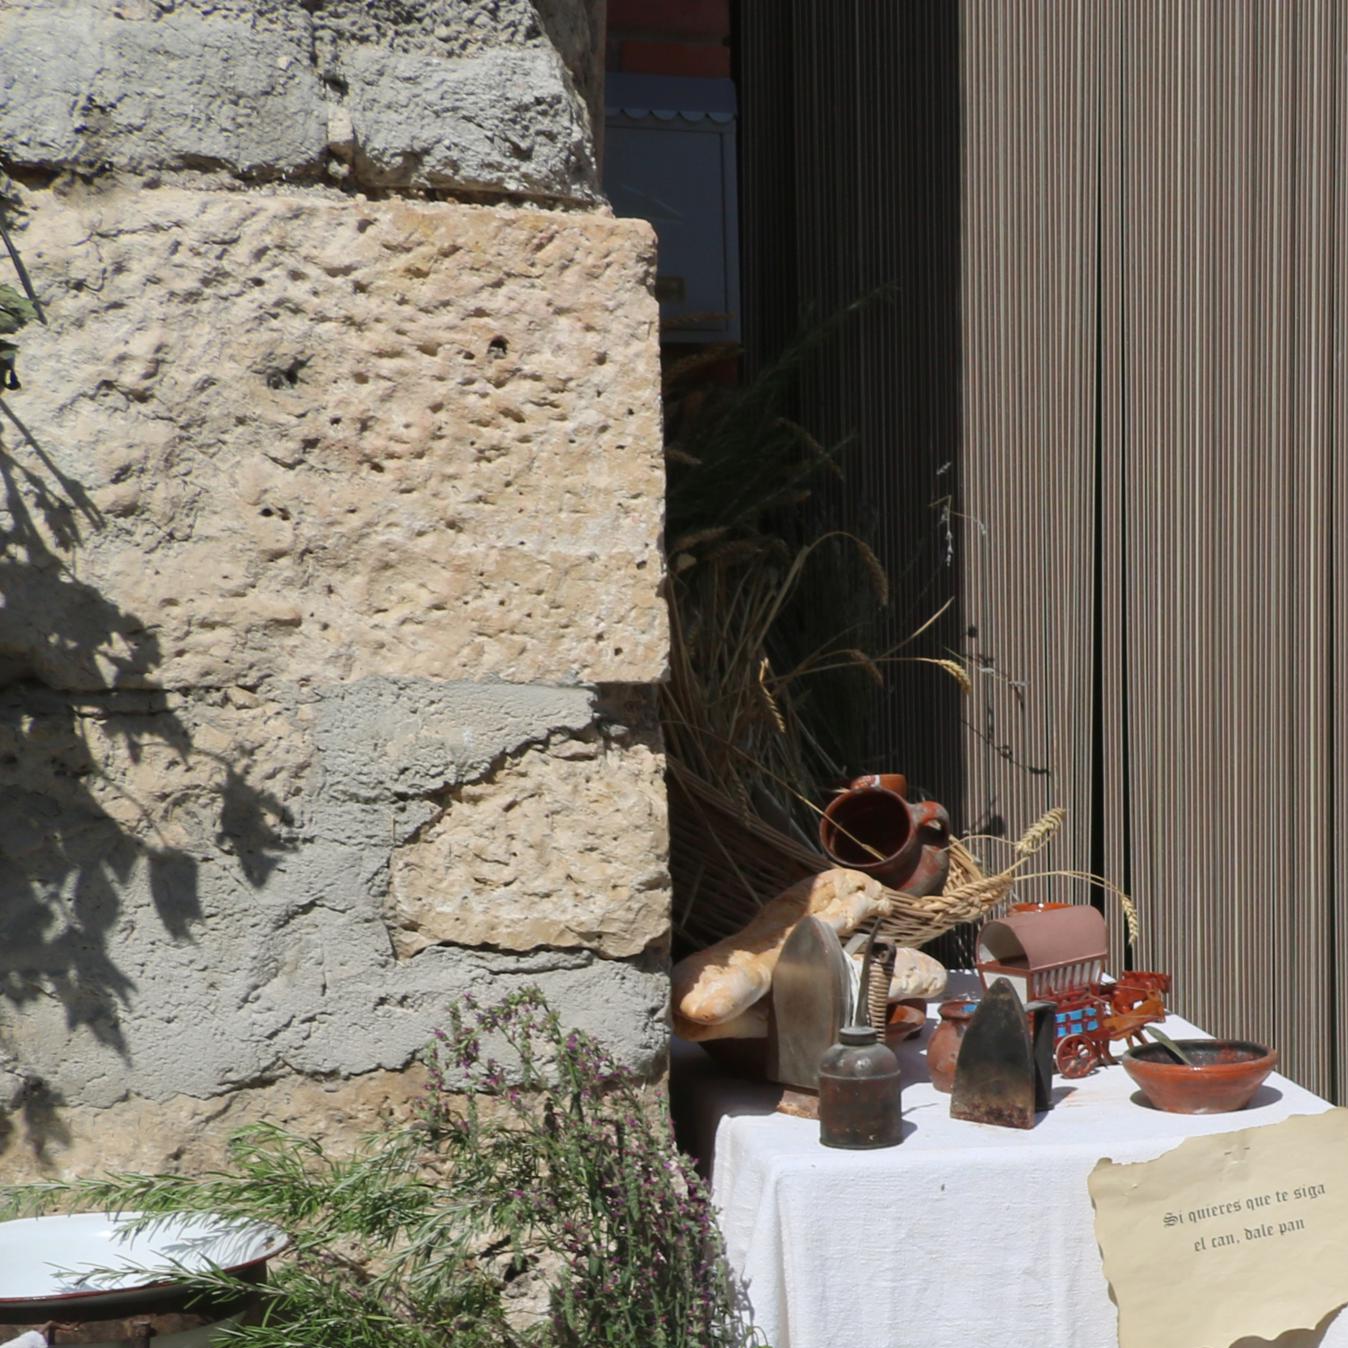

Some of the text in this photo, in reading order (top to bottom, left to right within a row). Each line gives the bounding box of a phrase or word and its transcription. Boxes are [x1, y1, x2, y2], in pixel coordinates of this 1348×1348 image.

[1163, 1183, 1326, 1228] Si quieres que te siga
[1194, 1218, 1305, 1252] el can, dale pan
